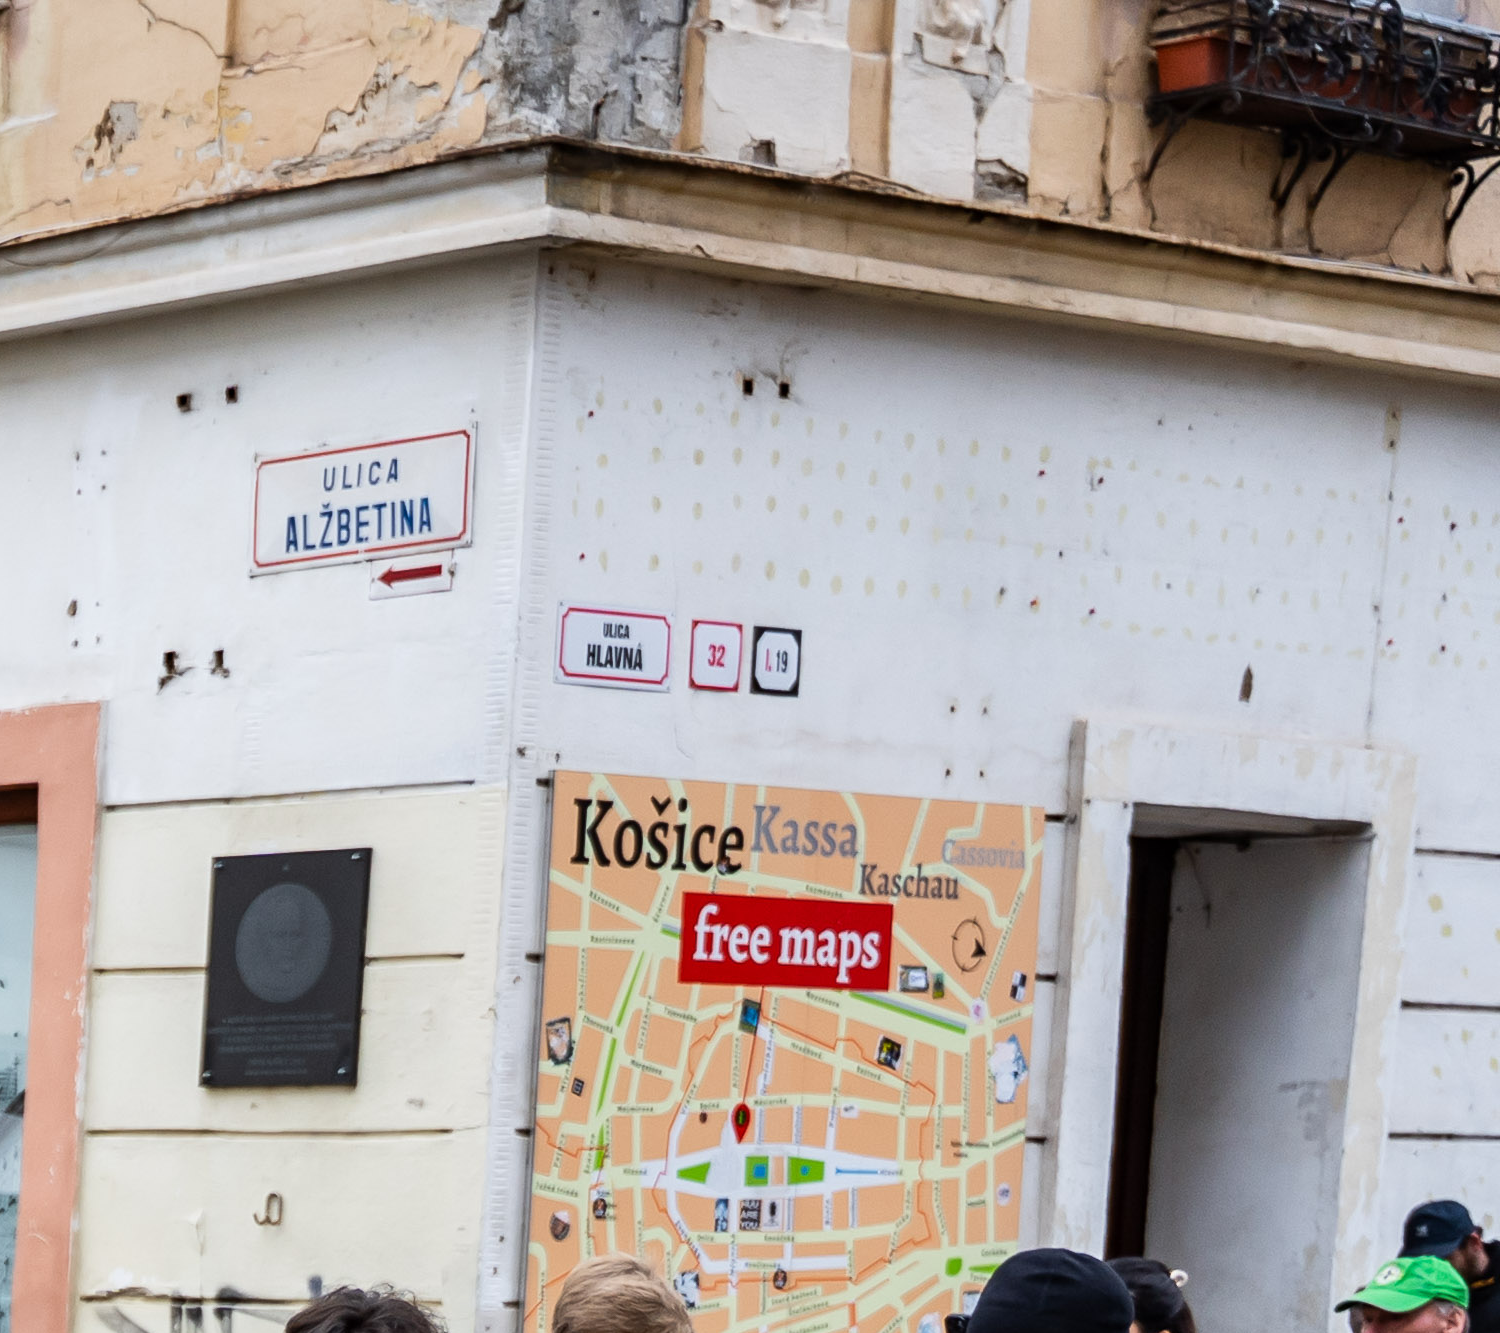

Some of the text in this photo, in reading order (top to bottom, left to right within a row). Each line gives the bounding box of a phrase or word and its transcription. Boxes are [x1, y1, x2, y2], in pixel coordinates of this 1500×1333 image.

[323, 457, 399, 492] ULICA
[285, 497, 431, 553] ALŽBETINA
[603, 622, 630, 639] ULICA
[586, 642, 643, 672] HLAVNÁ
[707, 644, 726, 668] 32
[776, 651, 789, 674] 19
[570, 795, 744, 876] Košice
[750, 804, 858, 857] Kassa
[941, 838, 1026, 870] Cassovia
[858, 862, 960, 900] Kaschau
[693, 903, 771, 964] free
[778, 926, 881, 984] maps
